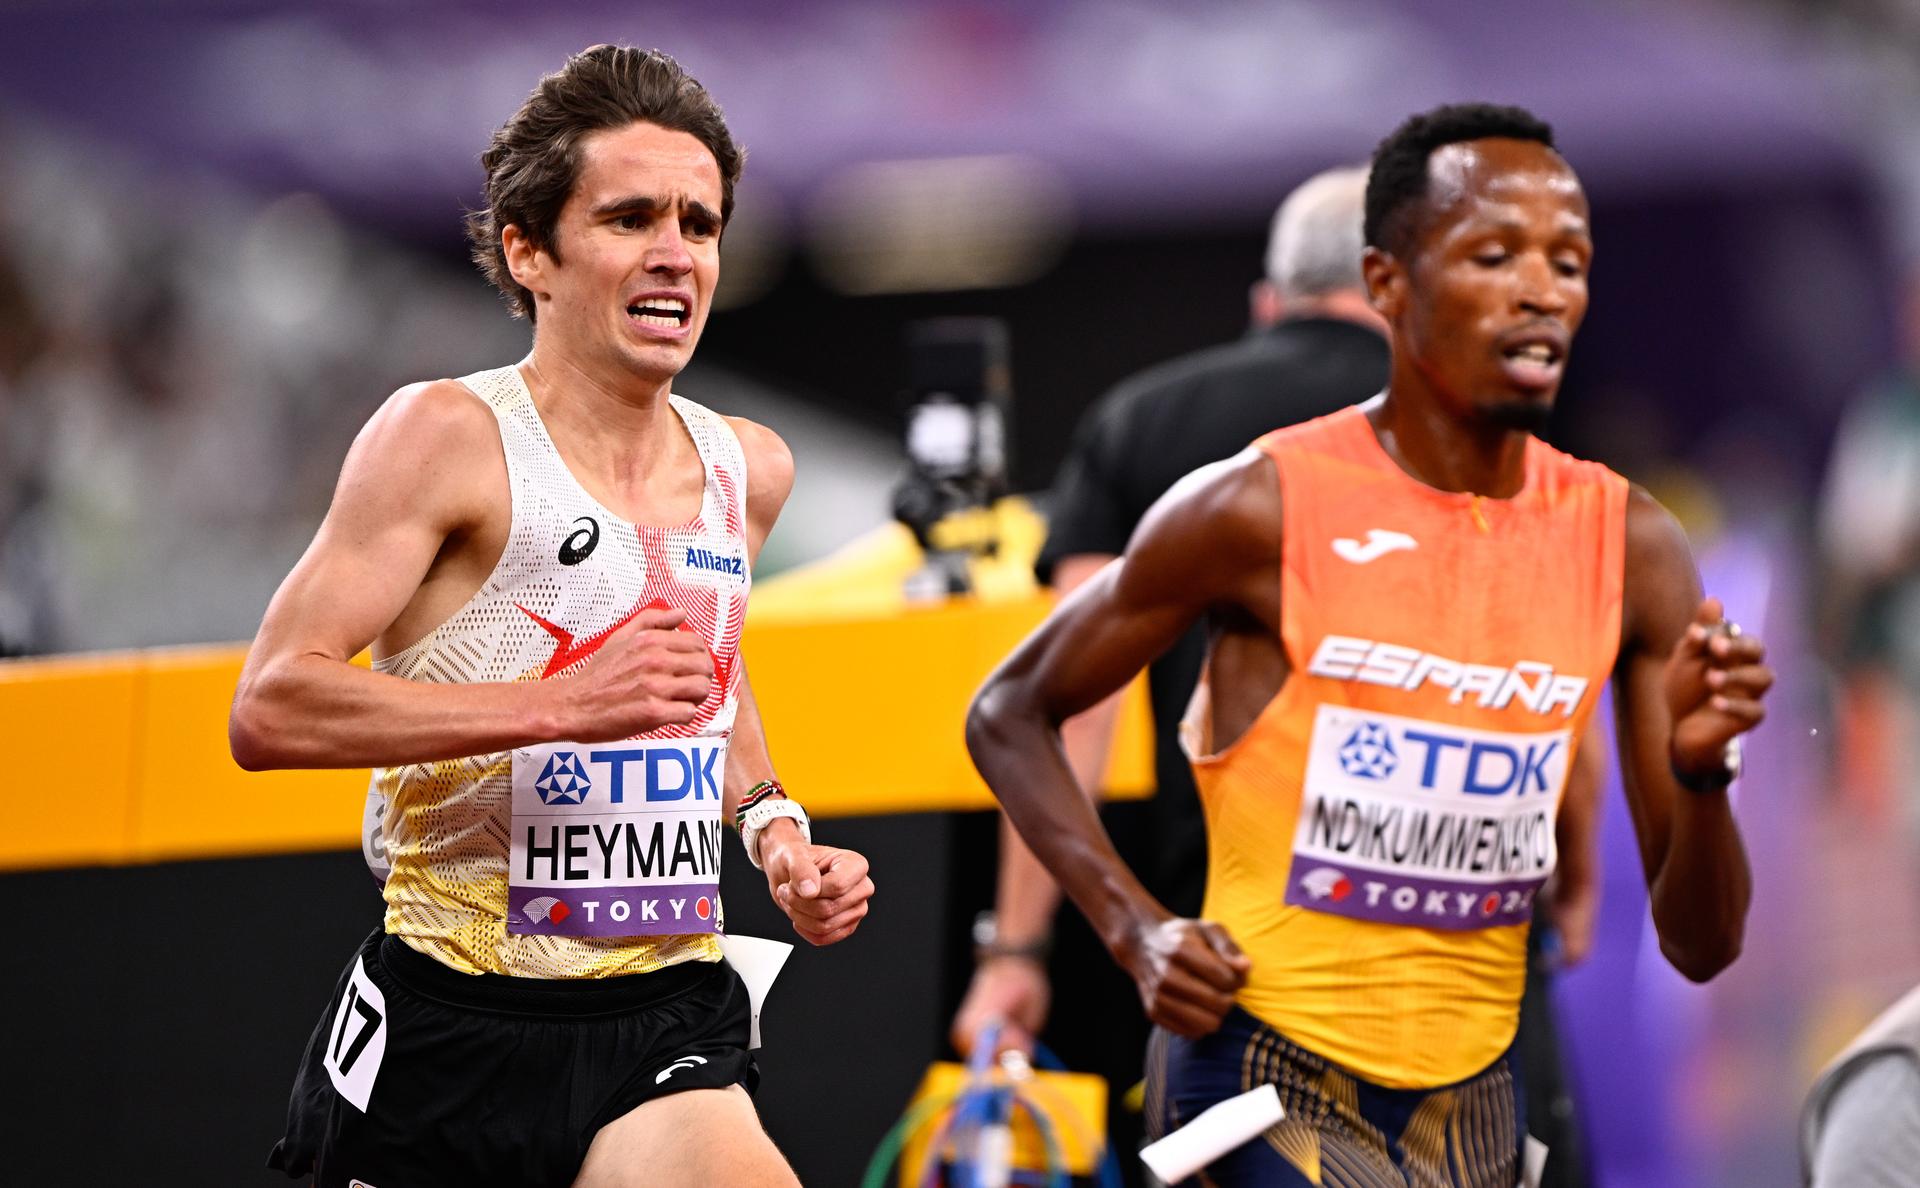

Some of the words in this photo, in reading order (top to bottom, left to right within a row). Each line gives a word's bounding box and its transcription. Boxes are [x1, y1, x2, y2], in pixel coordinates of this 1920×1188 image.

[686, 548, 742, 575] Allianz
[1308, 634, 1589, 718] ESPAÑA
[590, 747, 720, 804] TDK
[1402, 729, 1559, 797] TDK
[525, 818, 720, 881] HEYMANS
[1308, 796, 1548, 873] NDIKUMWENAYO
[333, 980, 384, 1078] 17
